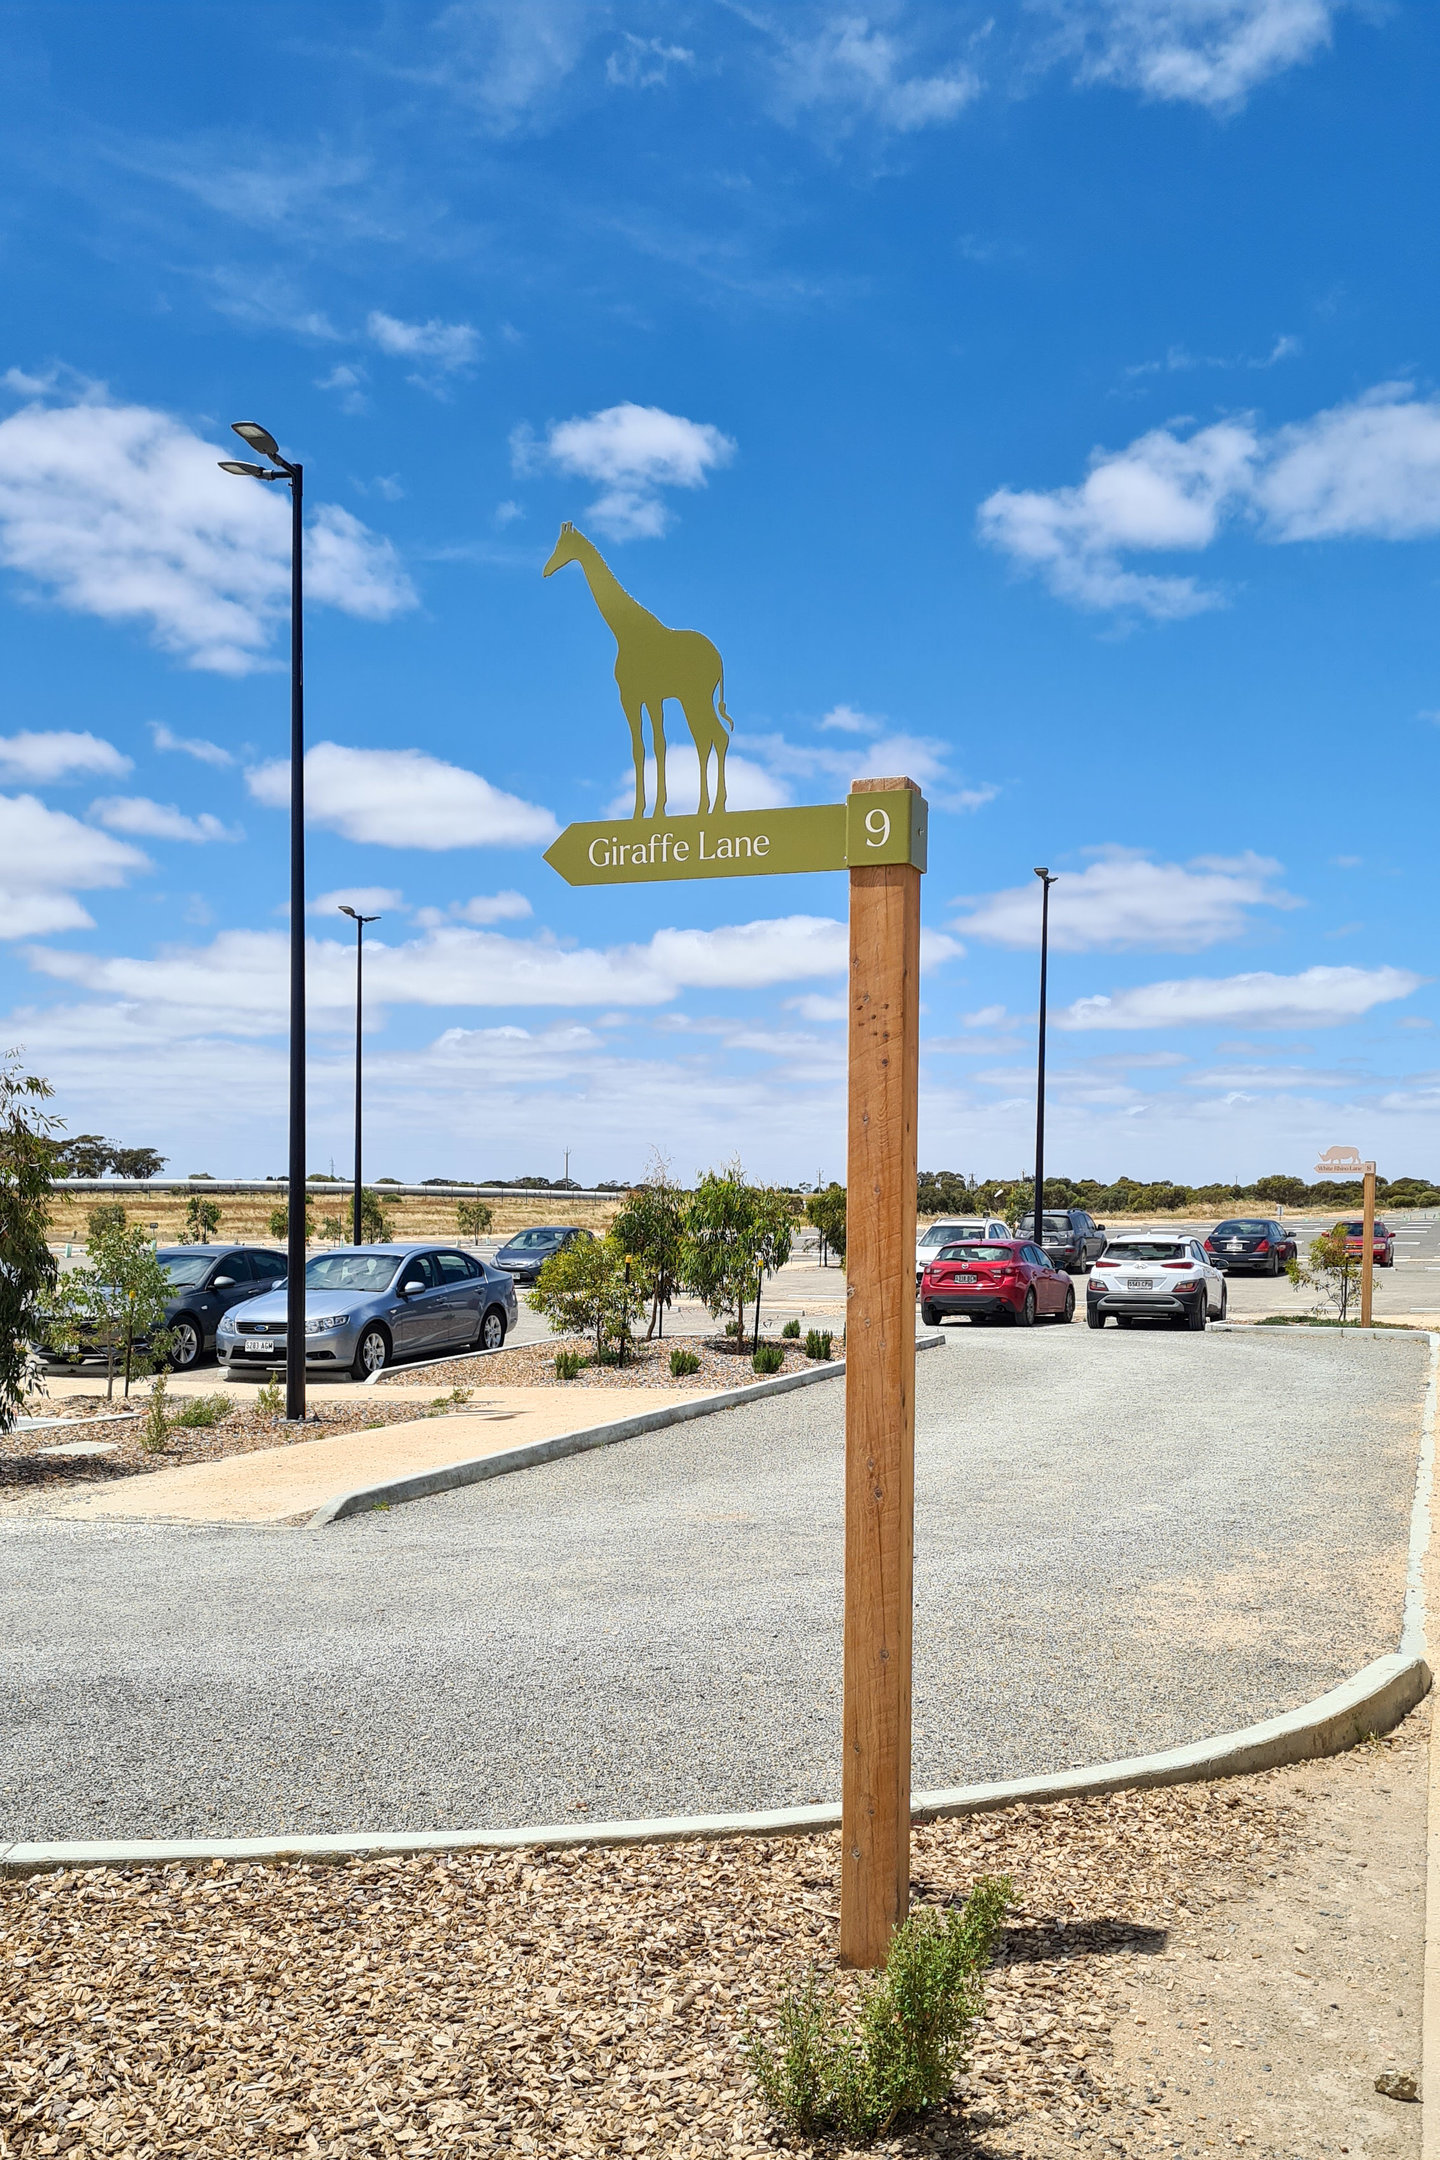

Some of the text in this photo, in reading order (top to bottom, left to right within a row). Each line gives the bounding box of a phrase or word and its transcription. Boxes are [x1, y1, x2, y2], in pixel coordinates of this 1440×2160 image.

[864, 808, 892, 847] 9
[588, 830, 771, 868] Giraffe Lane
